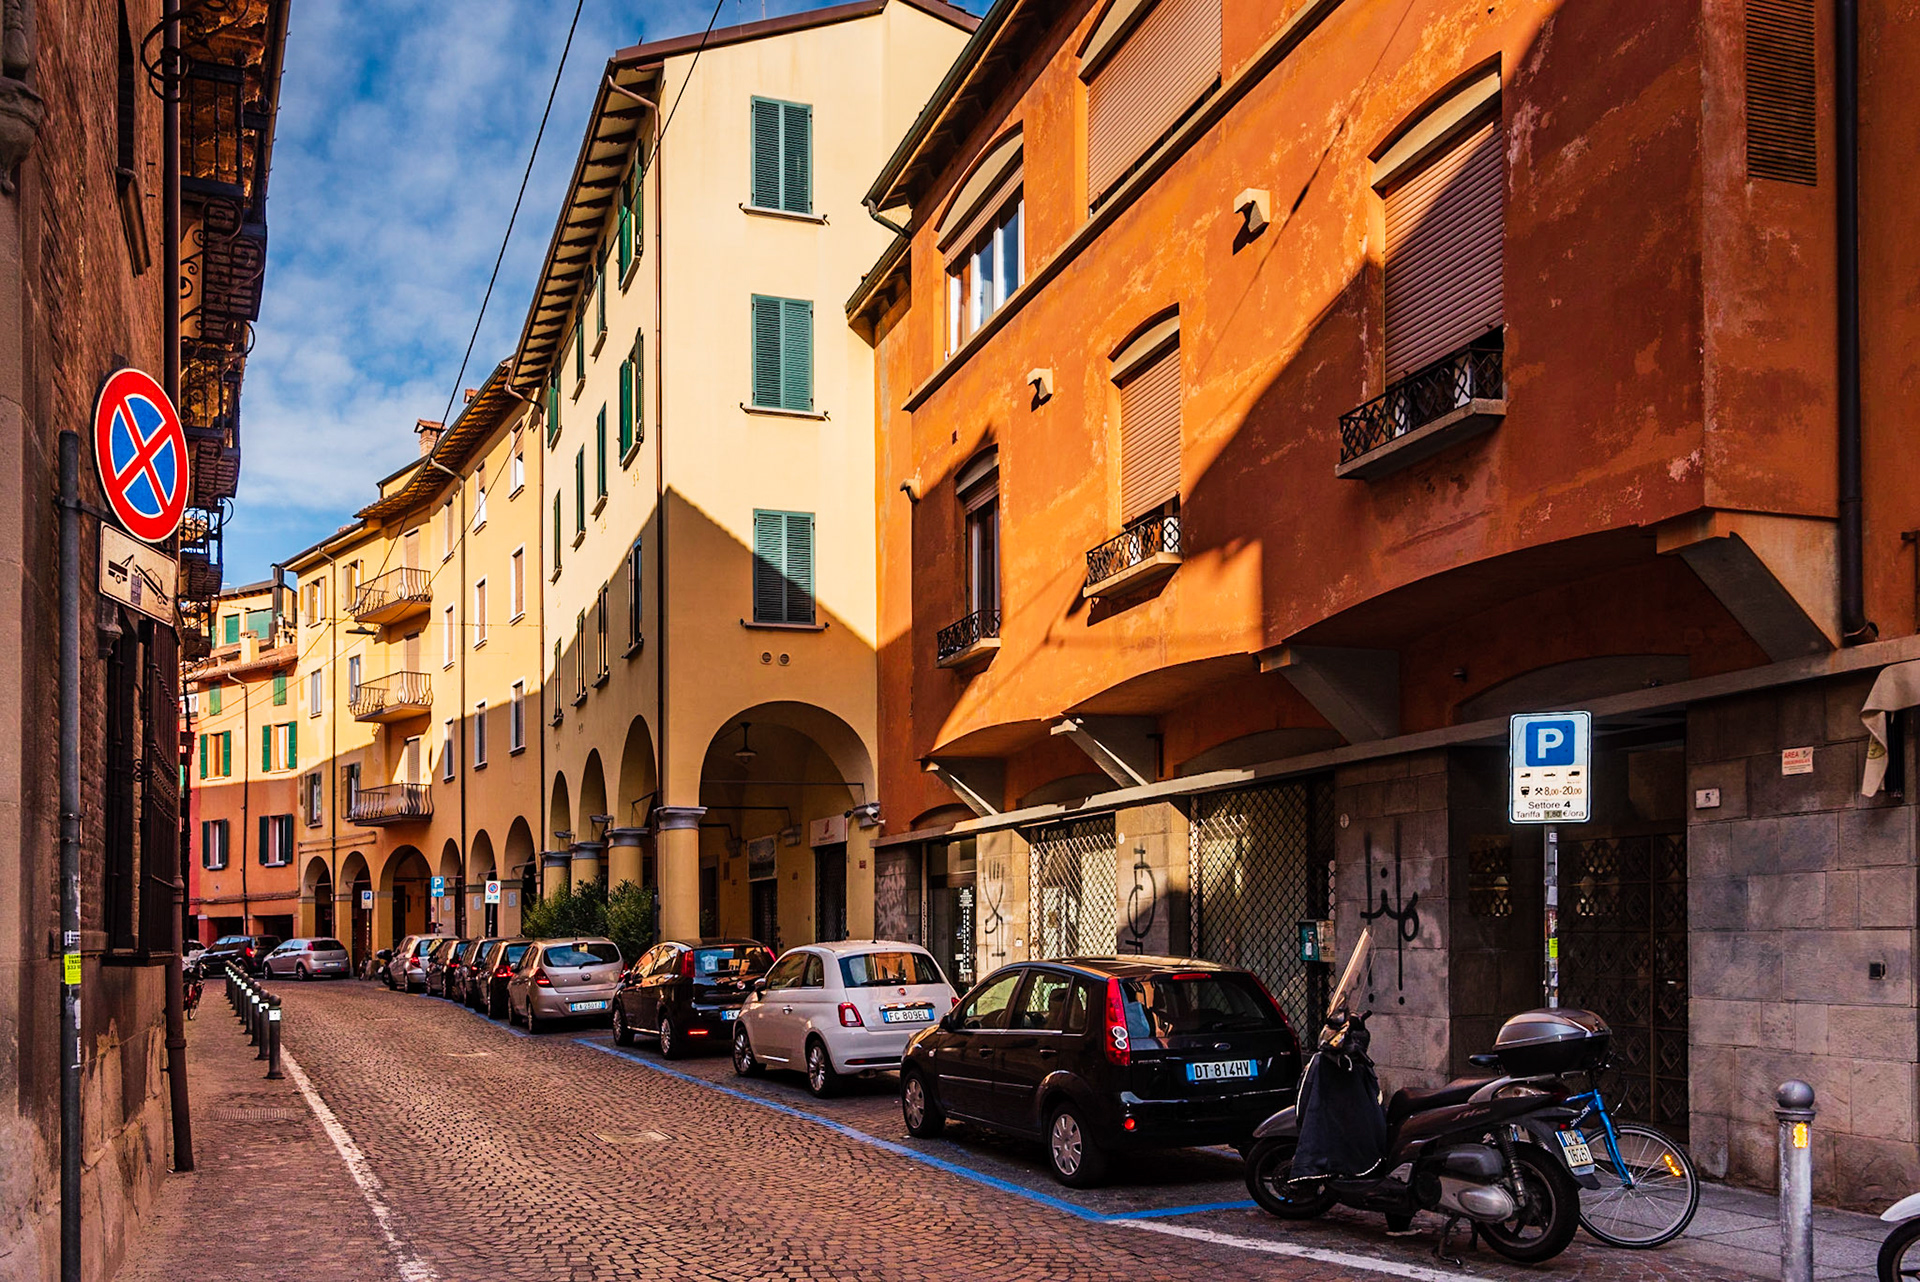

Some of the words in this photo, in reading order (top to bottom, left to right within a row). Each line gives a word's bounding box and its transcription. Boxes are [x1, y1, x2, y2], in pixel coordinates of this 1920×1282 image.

[1537, 728, 1564, 759] P
[1528, 801, 1560, 809] Settore
[1516, 810, 1540, 818] Tariffa
[434, 878, 441, 887] P
[902, 1010, 928, 1020] 809EL
[1195, 1064, 1210, 1078] DT
[1215, 1062, 1250, 1078] 814HV
